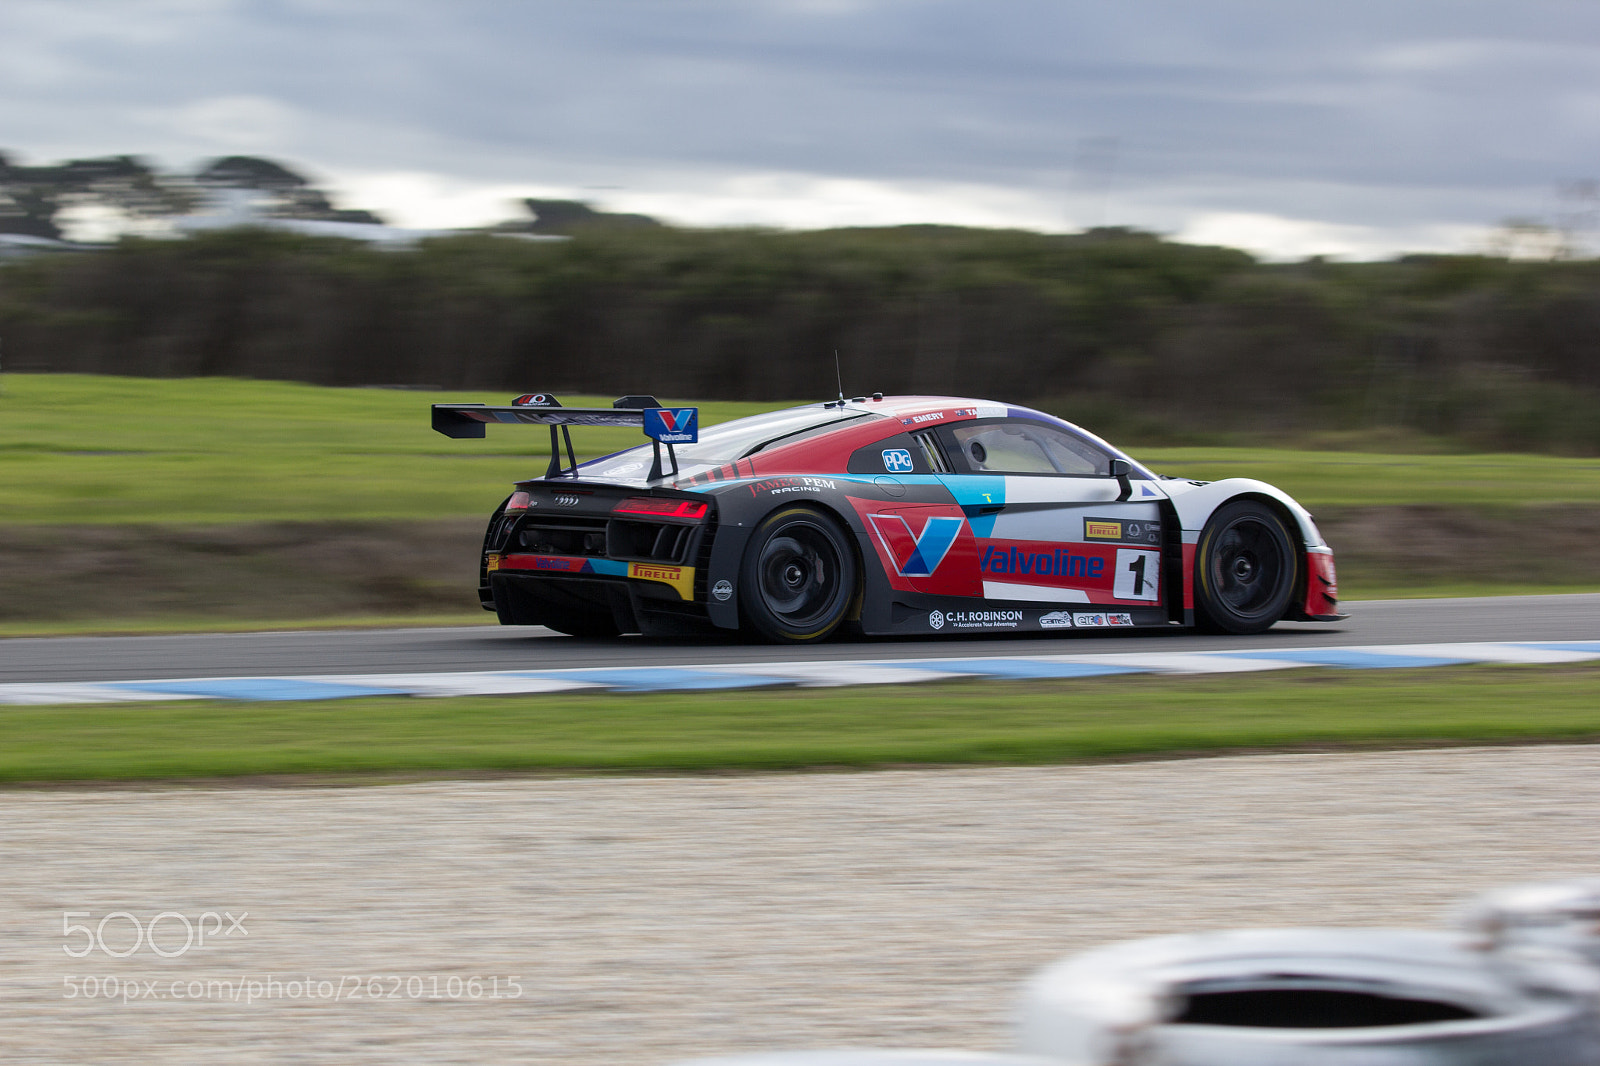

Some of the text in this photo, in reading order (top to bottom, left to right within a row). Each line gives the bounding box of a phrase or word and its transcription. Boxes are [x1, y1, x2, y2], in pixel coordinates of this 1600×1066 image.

[913, 412, 944, 423] EMERY
[659, 433, 693, 441] Valvoline
[885, 452, 911, 470] PPG
[748, 477, 836, 498] JAMEC PEM
[771, 486, 820, 495] RACING
[1089, 525, 1119, 536] PIRELLI
[536, 557, 570, 570] Valvoline
[976, 545, 1104, 578] Valvoline
[633, 564, 681, 580] PIRELLI
[1129, 555, 1146, 596] 1
[946, 611, 1023, 621] C.H. ROBINSON
[1077, 615, 1093, 626] elf
